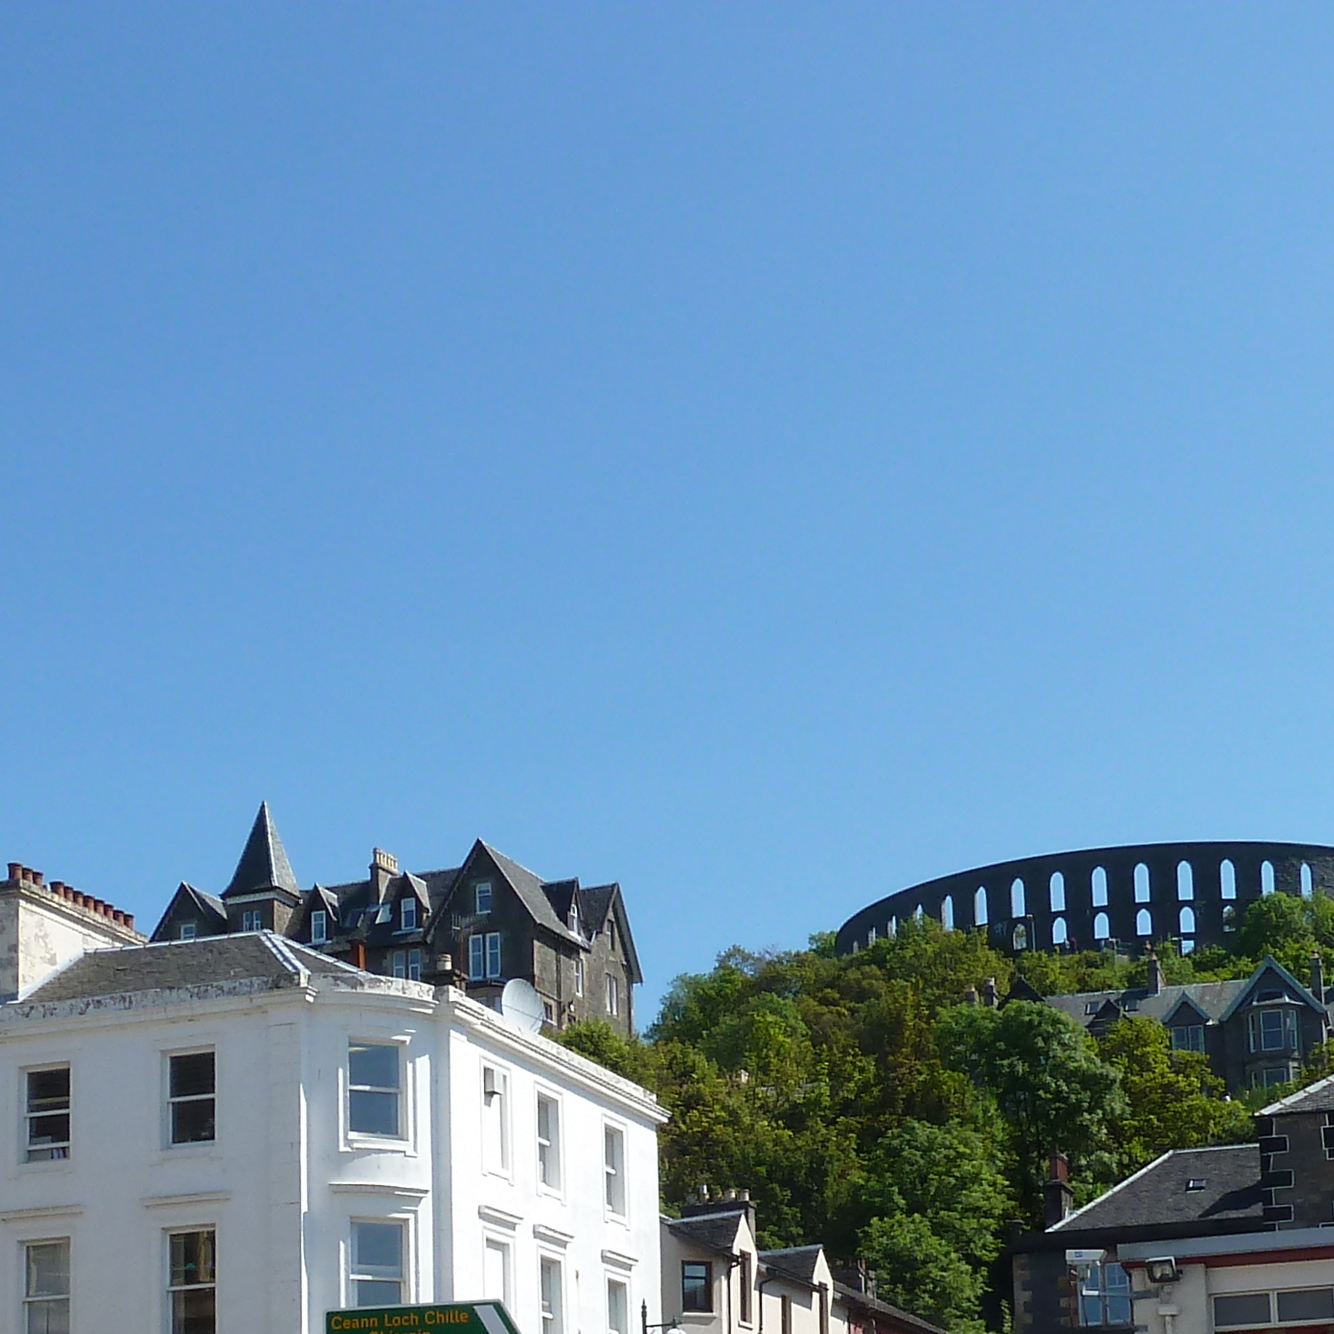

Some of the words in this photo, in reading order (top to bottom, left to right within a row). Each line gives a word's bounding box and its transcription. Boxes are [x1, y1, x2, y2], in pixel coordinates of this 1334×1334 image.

[331, 1316, 378, 1330] Ceann
[384, 1313, 418, 1327] Loch
[424, 1310, 469, 1325] Chille
